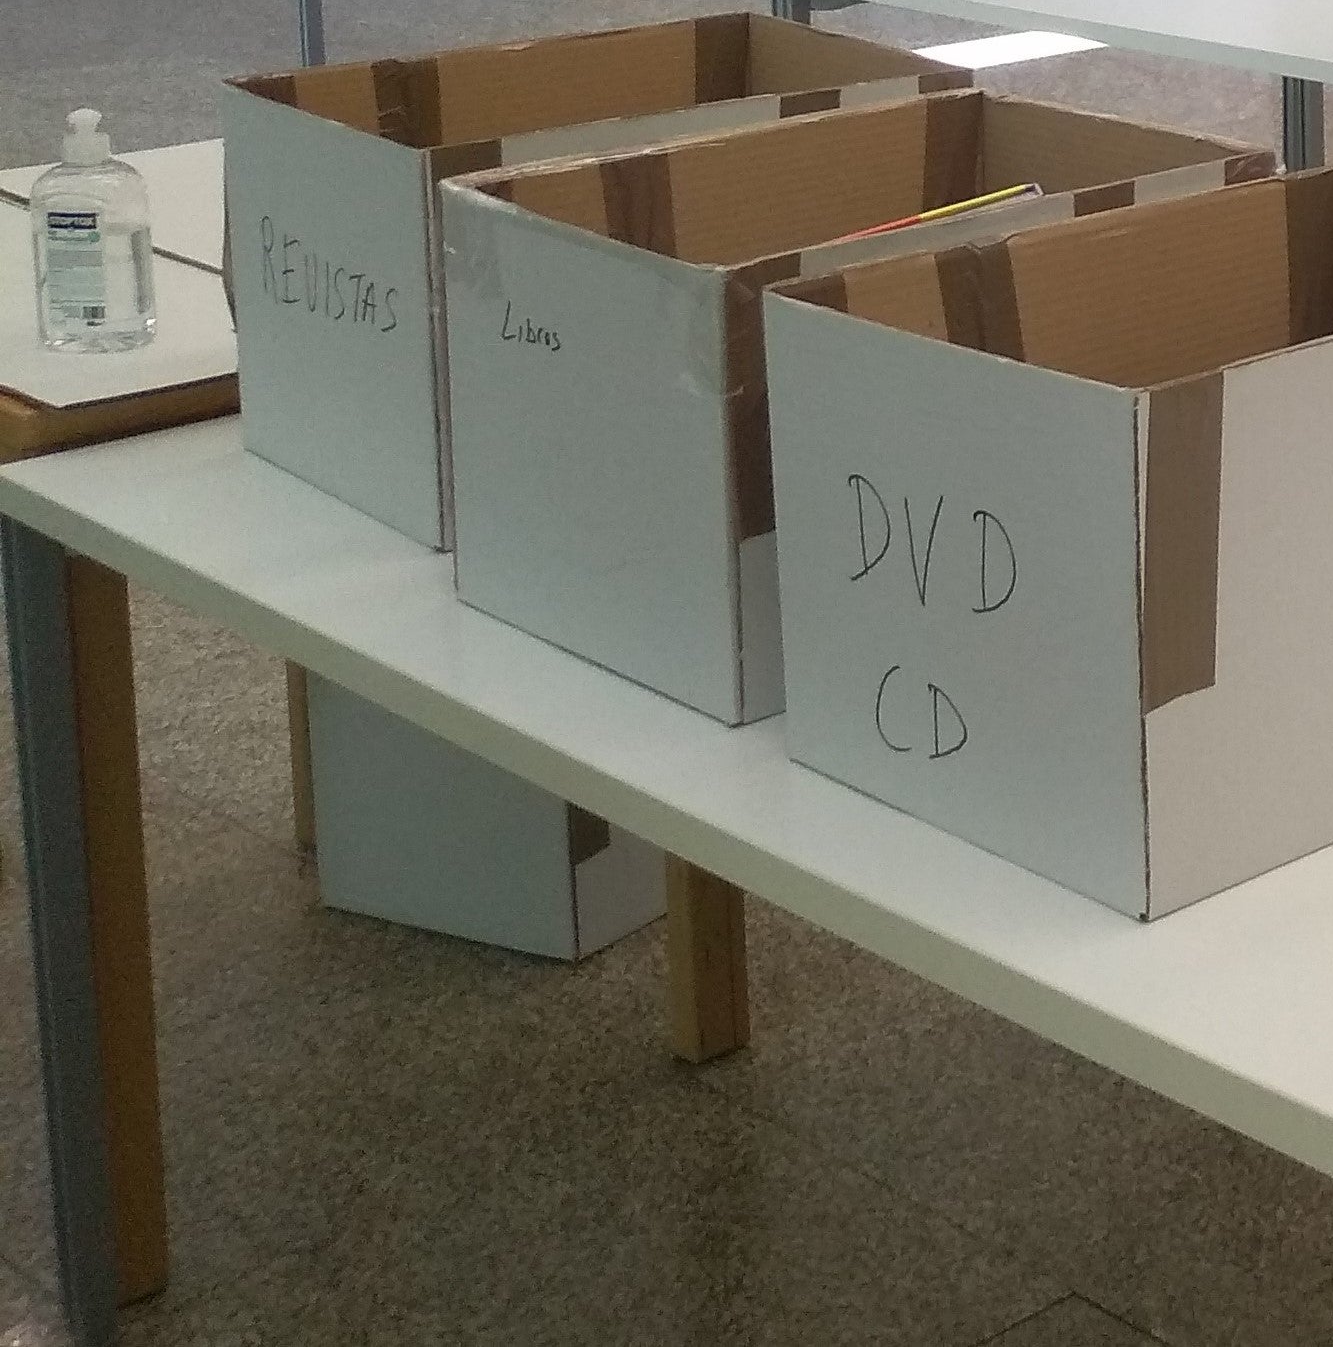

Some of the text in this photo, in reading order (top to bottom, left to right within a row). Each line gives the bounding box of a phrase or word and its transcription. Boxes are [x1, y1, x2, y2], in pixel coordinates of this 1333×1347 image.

[501, 300, 562, 351] Libros
[848, 474, 1017, 613] DVD
[876, 665, 968, 759] CD
